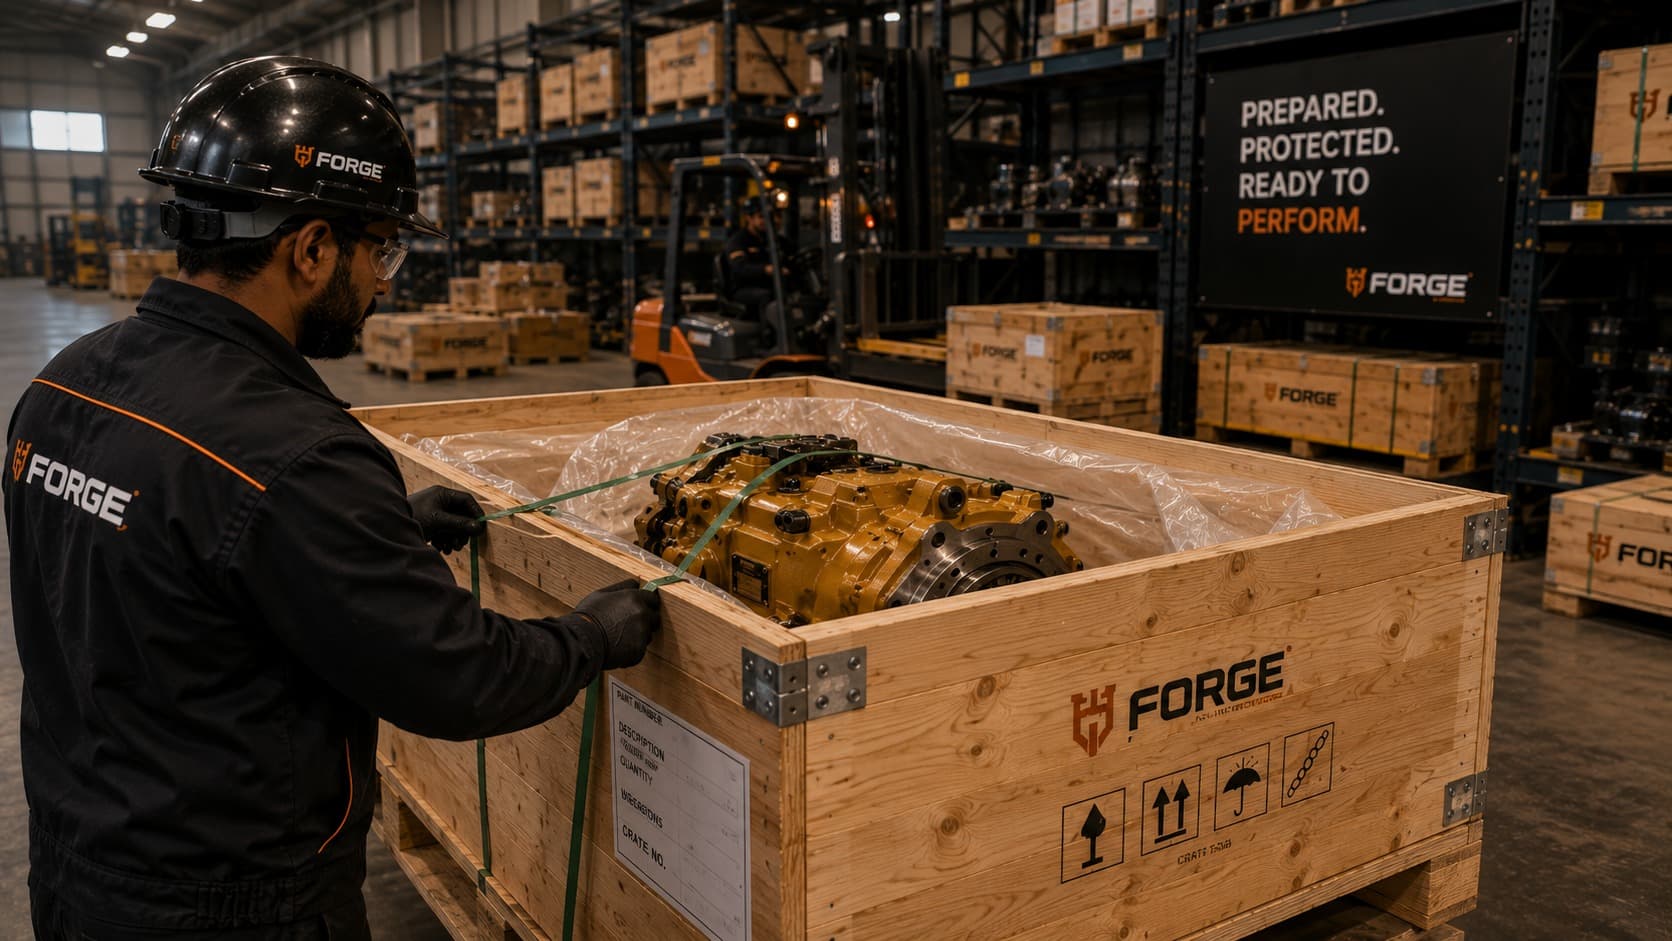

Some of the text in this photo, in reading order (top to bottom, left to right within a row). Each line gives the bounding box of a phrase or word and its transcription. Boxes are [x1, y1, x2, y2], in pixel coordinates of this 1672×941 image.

[1241, 88, 1385, 128] PREPARED.
[1240, 126, 1400, 164] PROTECTED.
[316, 151, 384, 180] FORGE
[1239, 167, 1370, 199] READY TO
[1237, 206, 1367, 234] PERFORM.
[1369, 272, 1469, 297] FORGE
[982, 344, 1018, 360] FORGE
[1091, 349, 1135, 363] FORGE
[1279, 386, 1338, 407] FORGE
[26, 452, 133, 527] FORGE
[1128, 650, 1285, 732] FORGE
[618, 720, 665, 762] DESCRIPTION
[620, 755, 653, 785] QUANTITY
[622, 824, 666, 870] CRATE NO.
